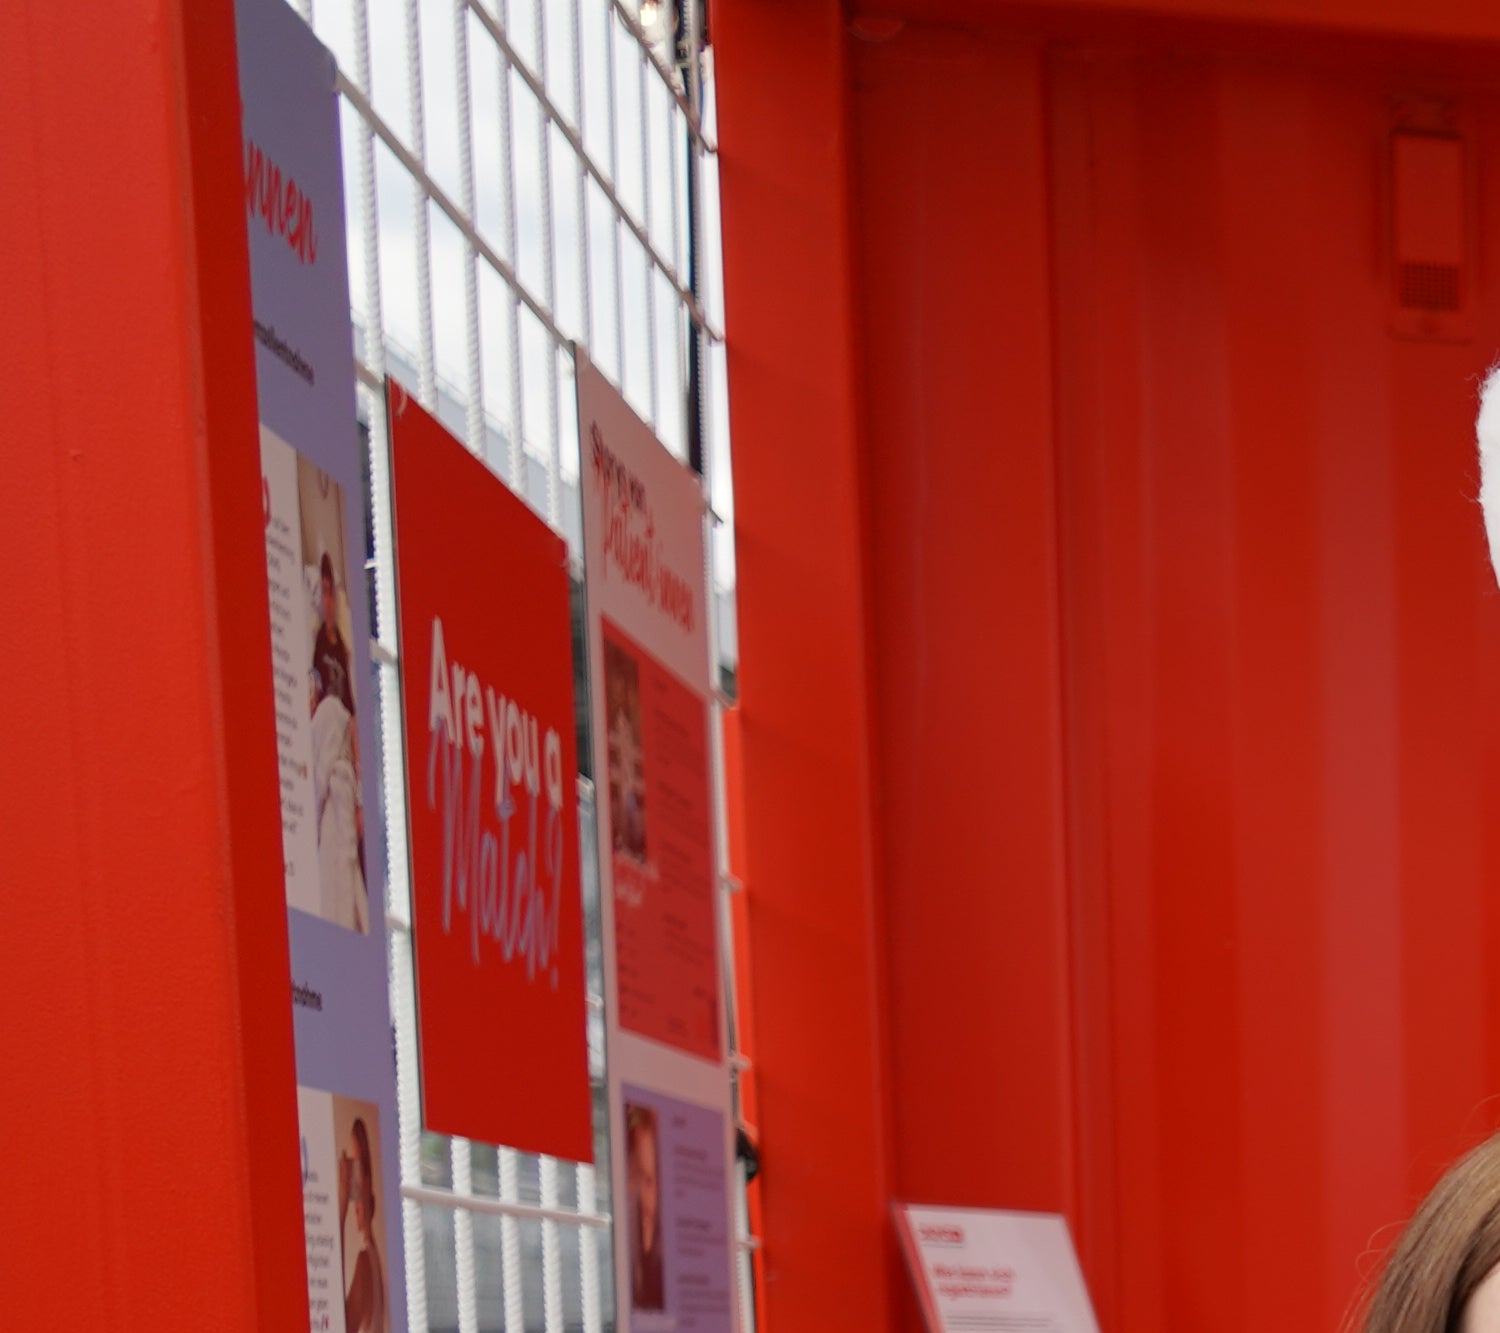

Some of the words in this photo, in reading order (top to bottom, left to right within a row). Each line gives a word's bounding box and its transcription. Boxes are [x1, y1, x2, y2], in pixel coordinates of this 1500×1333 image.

[245, 140, 318, 265] nnen
[429, 615, 484, 759] Are
[487, 683, 541, 808] you
[545, 726, 563, 811] a
[427, 718, 564, 992] Match?
